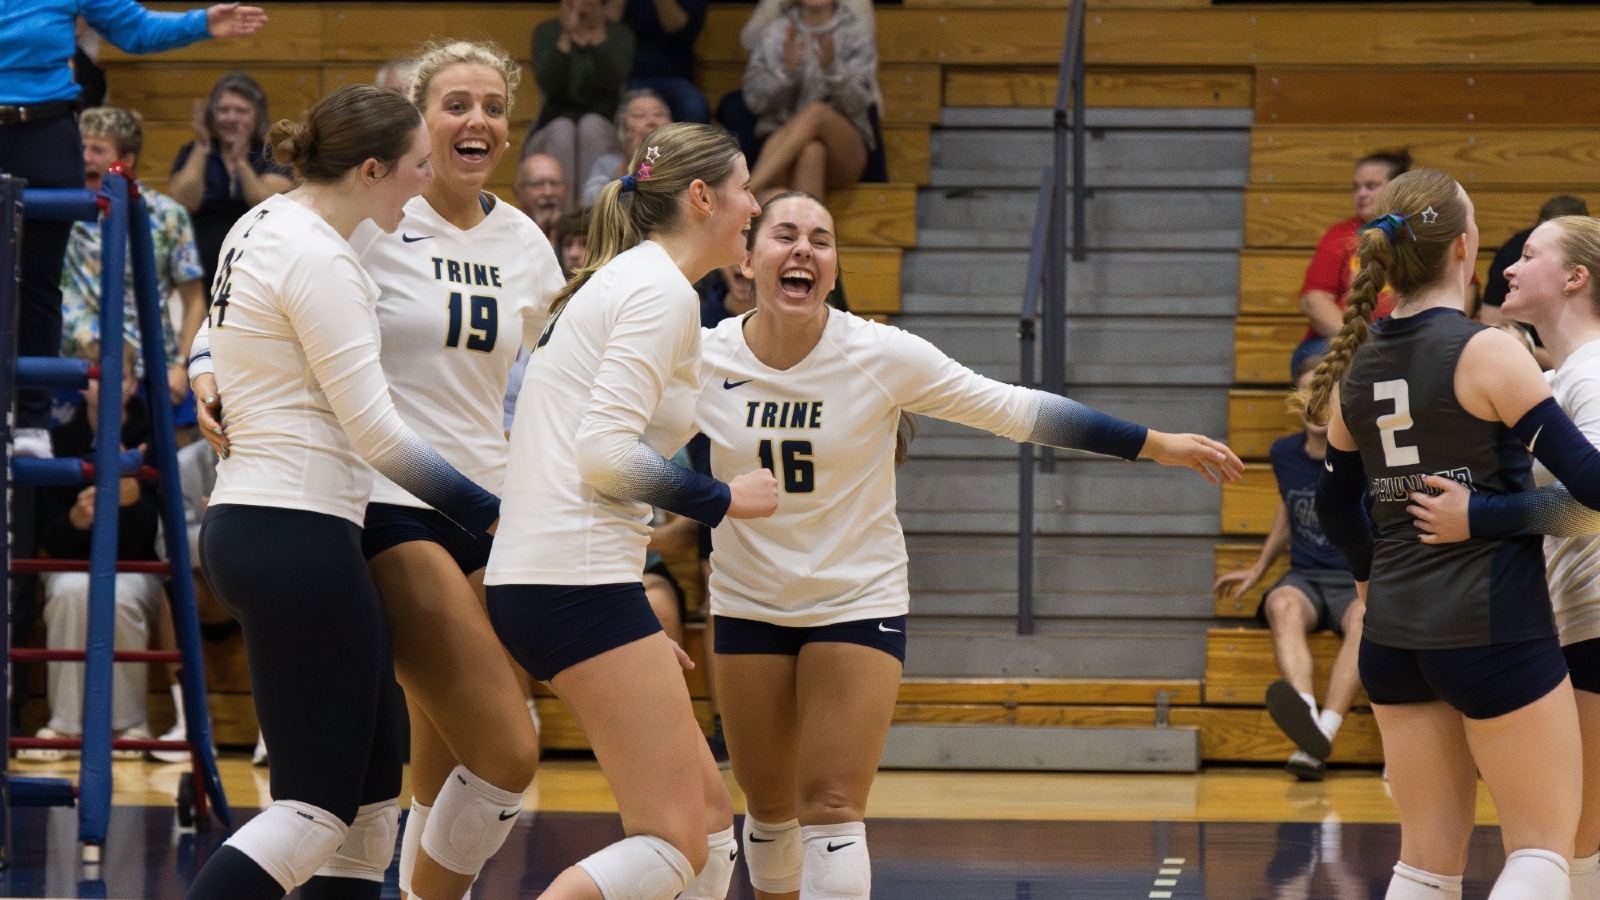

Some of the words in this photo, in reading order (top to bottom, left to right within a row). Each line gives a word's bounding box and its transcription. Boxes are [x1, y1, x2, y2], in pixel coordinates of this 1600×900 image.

[431, 256, 503, 288] TRINE
[444, 291, 499, 354] 19
[745, 400, 824, 429] TRINE
[1373, 378, 1421, 468] 2
[757, 437, 816, 495] 16
